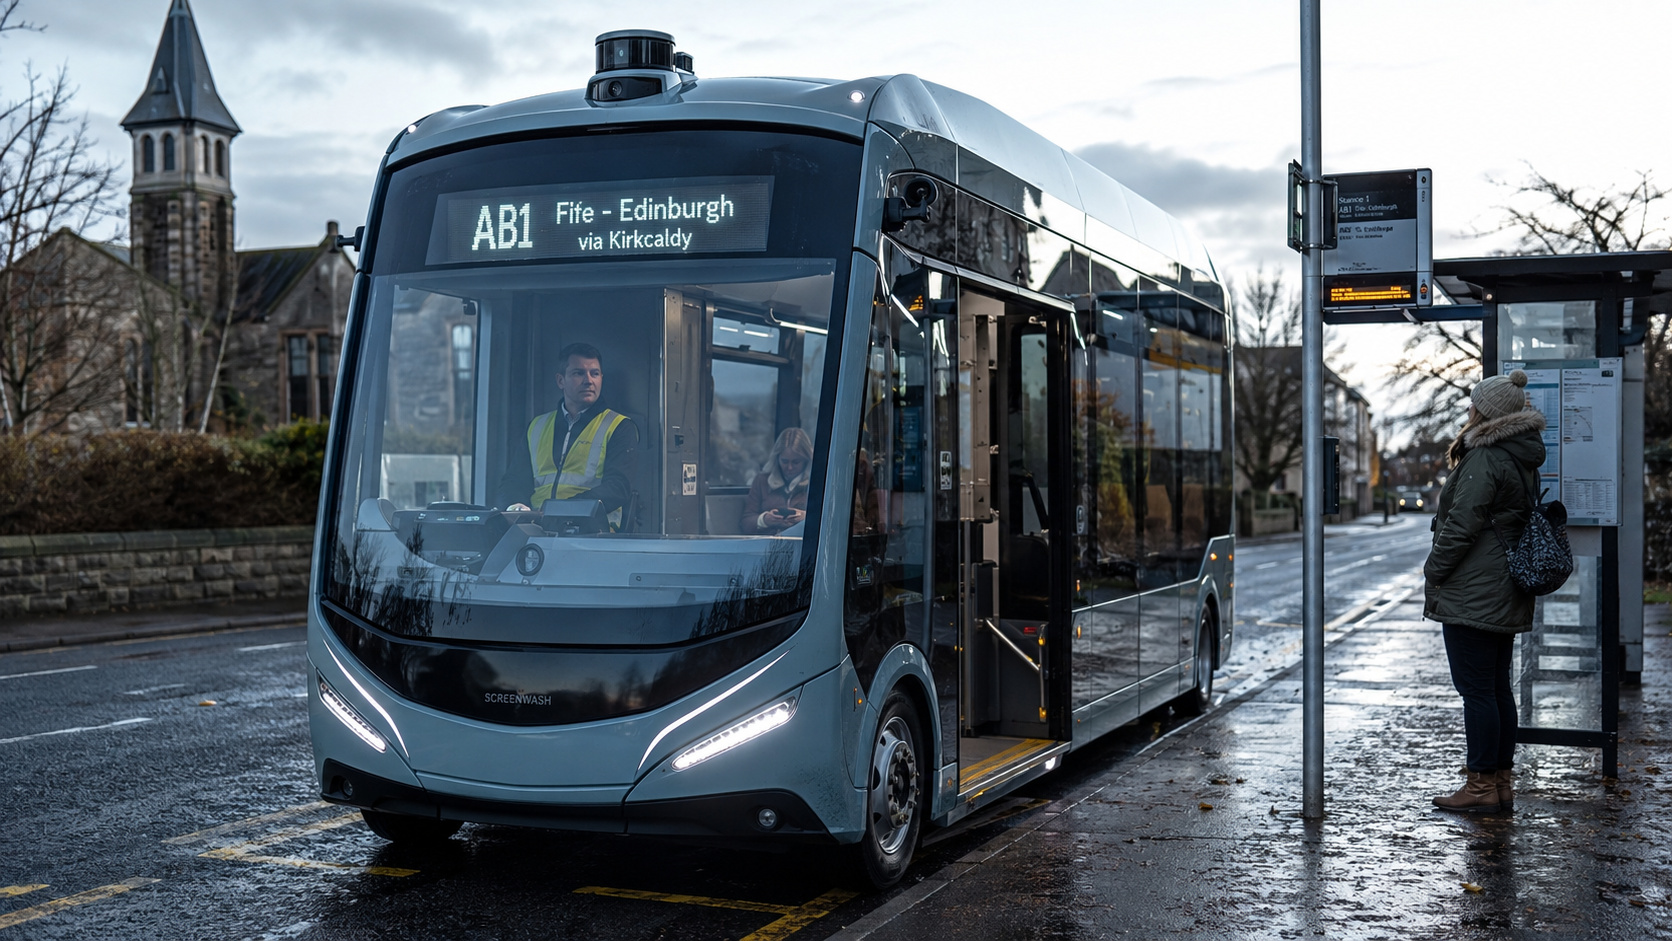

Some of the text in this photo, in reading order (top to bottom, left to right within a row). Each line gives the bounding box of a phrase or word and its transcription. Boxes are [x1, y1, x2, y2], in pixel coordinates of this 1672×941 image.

[556, 201, 594, 224] Fife
[620, 194, 734, 224] Edinburgh
[472, 203, 533, 251] AB1
[578, 228, 692, 251] via Kirkcaldy
[484, 692, 552, 706] SCREENWASH
